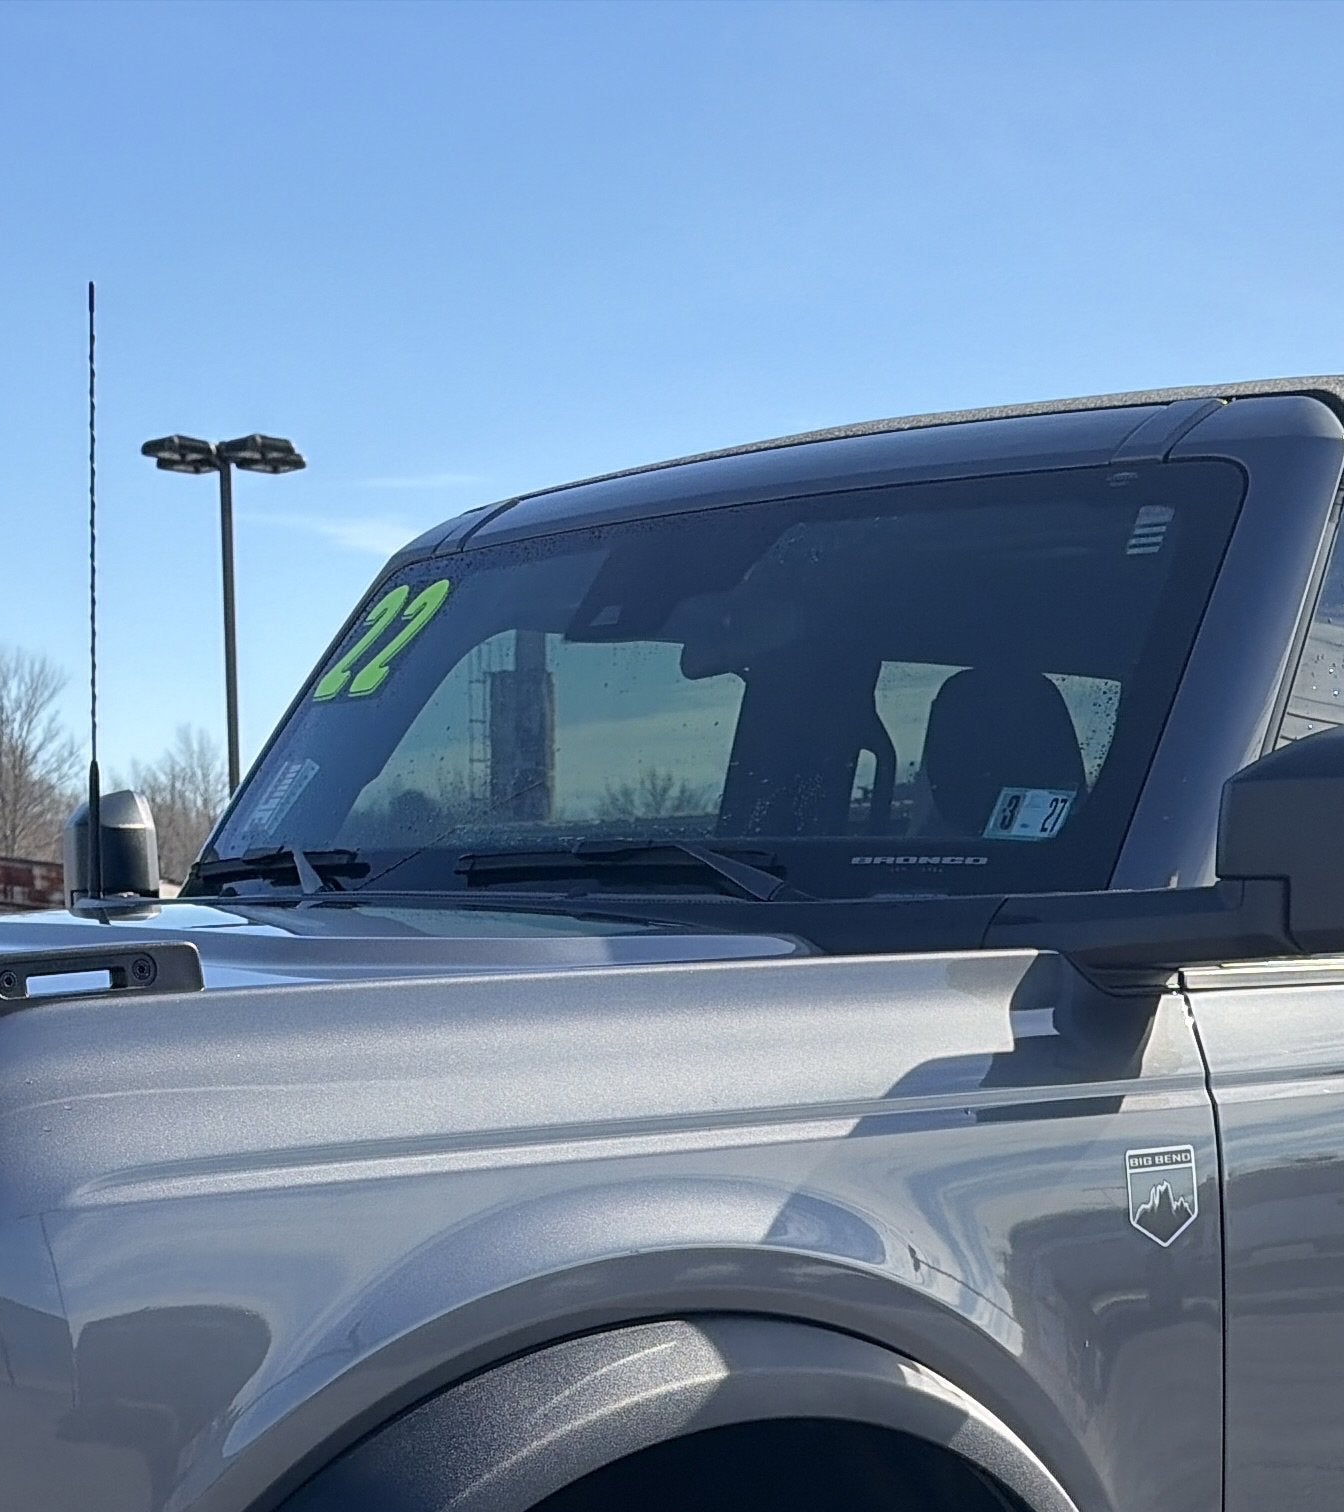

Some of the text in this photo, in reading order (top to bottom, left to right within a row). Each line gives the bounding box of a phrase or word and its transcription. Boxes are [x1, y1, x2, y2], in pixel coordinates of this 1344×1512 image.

[312, 579, 450, 702] 22
[1040, 797, 1069, 833] 27
[851, 856, 989, 865] BRONCO
[1130, 1153, 1191, 1167] BIG BEND
